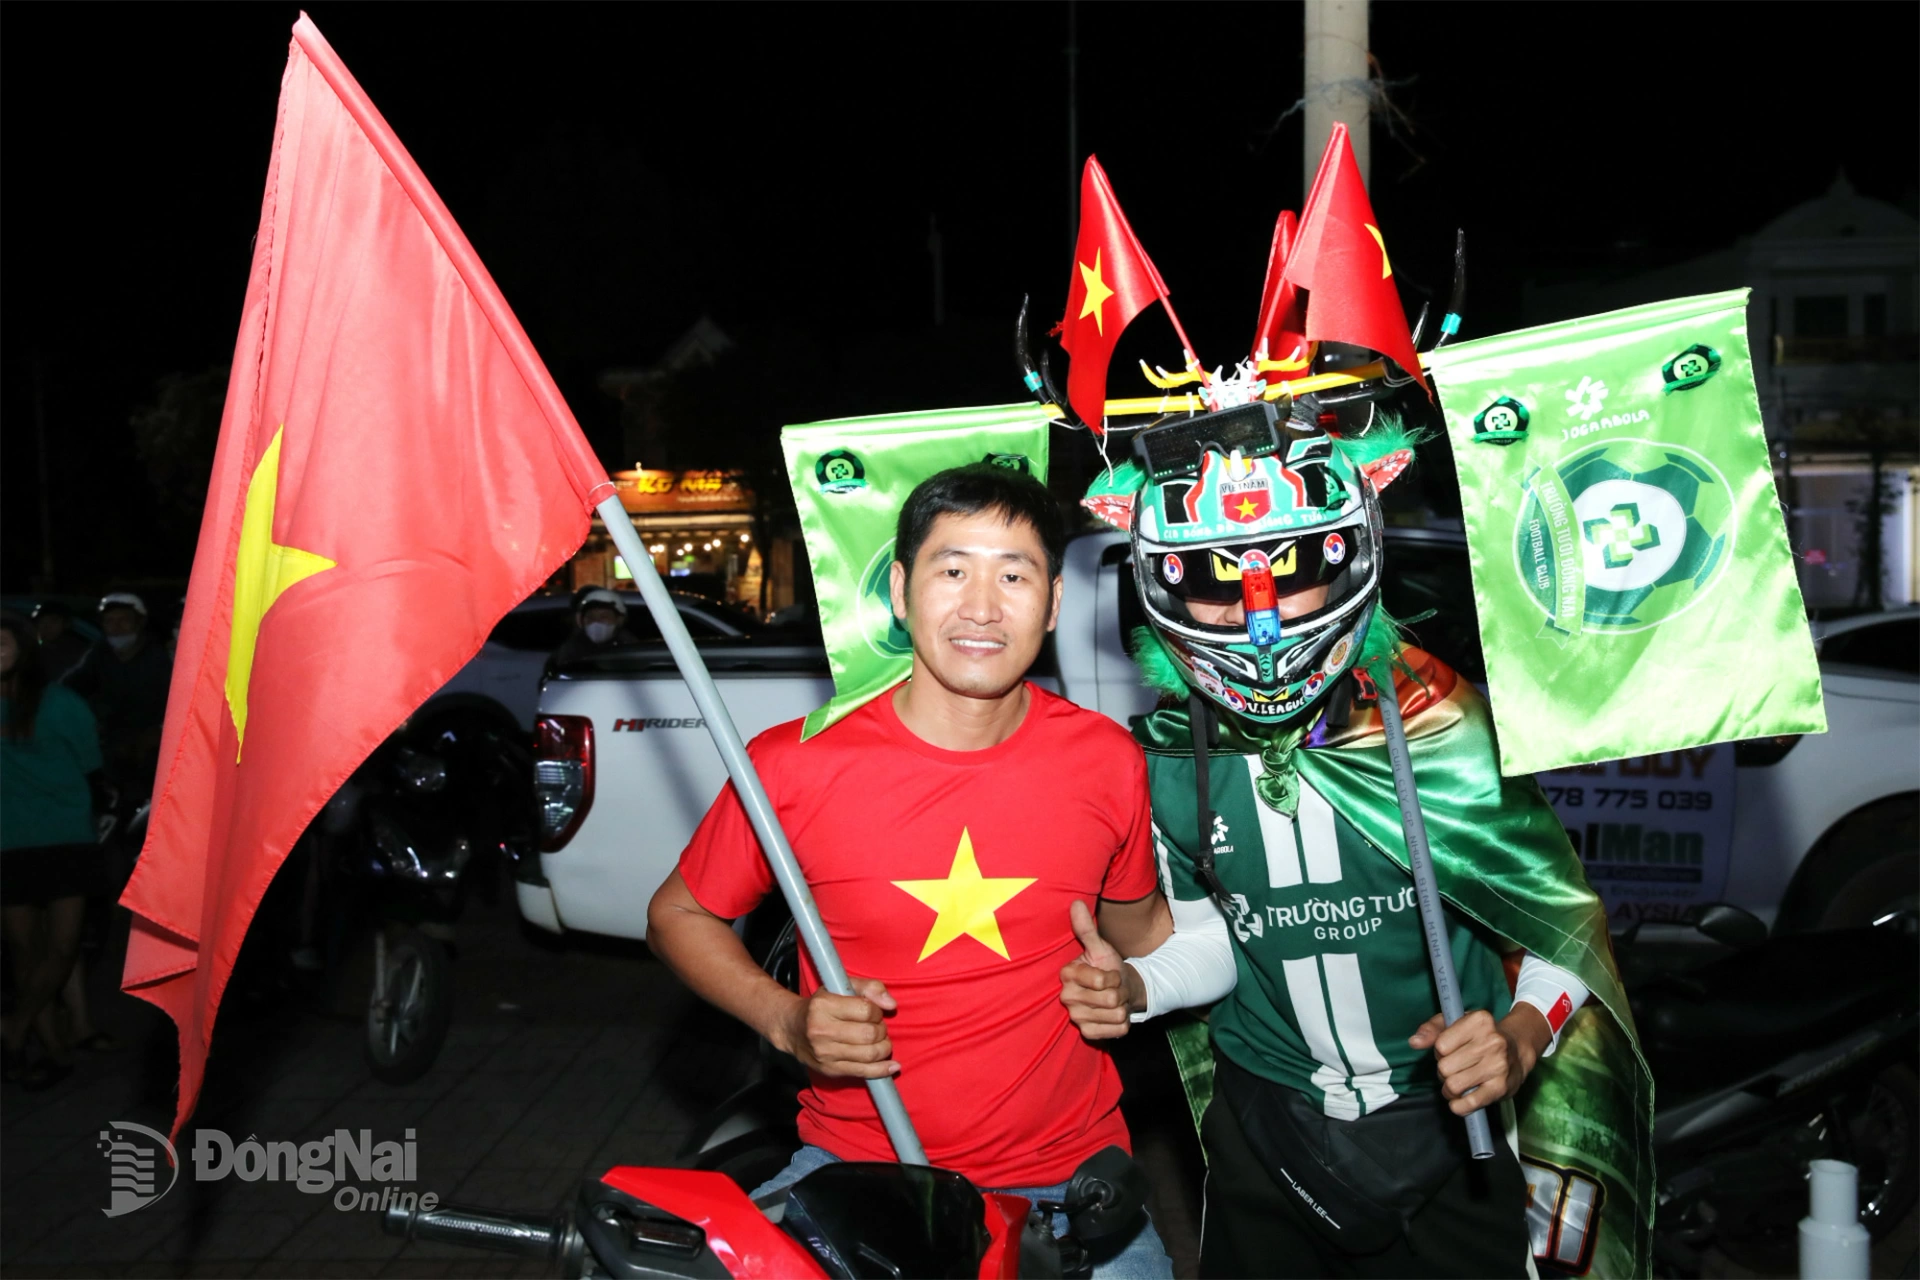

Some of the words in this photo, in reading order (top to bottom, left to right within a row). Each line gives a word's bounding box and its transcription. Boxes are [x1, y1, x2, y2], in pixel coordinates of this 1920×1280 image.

[1529, 519, 1545, 564] FOOTBALL
[1536, 564, 1550, 590] CLUB
[1541, 786, 1584, 807] 78
[1594, 788, 1648, 809] 775
[1657, 790, 1713, 811] 039
[1266, 897, 1365, 928] TRƯỜNG
[1314, 917, 1383, 941] GROUP
[1292, 1181, 1314, 1206] LABER
[1312, 1202, 1327, 1218] LEE
